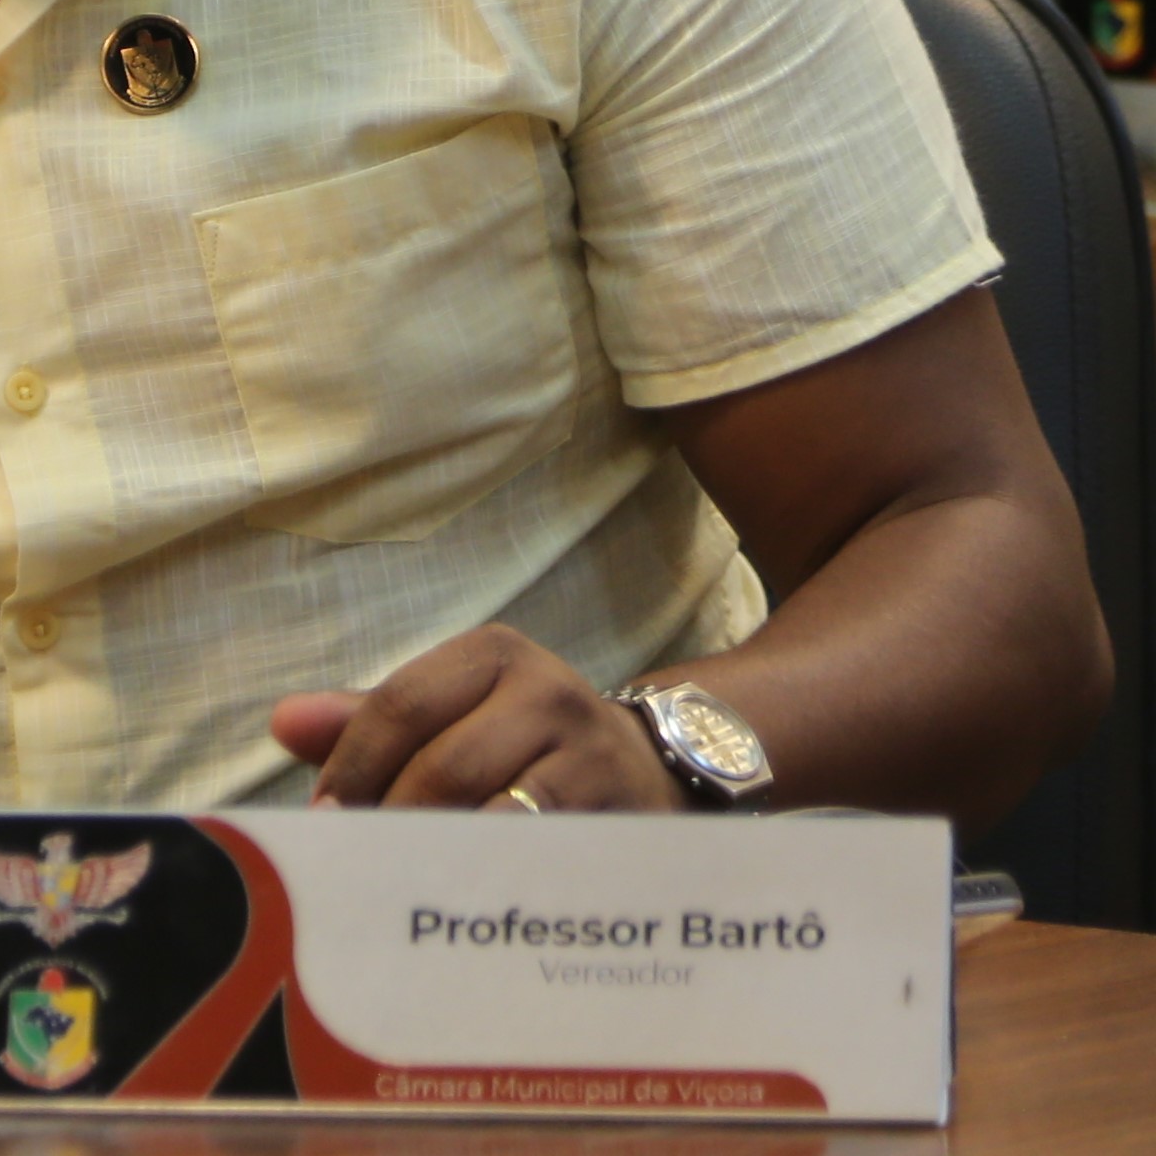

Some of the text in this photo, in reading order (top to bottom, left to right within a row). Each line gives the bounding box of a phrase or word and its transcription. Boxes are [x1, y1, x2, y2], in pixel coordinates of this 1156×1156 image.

[410, 907, 826, 951] Professor Bartô
[538, 960, 693, 988] Vereador
[374, 1071, 765, 1108] Câmara Municipal de Viçosa
